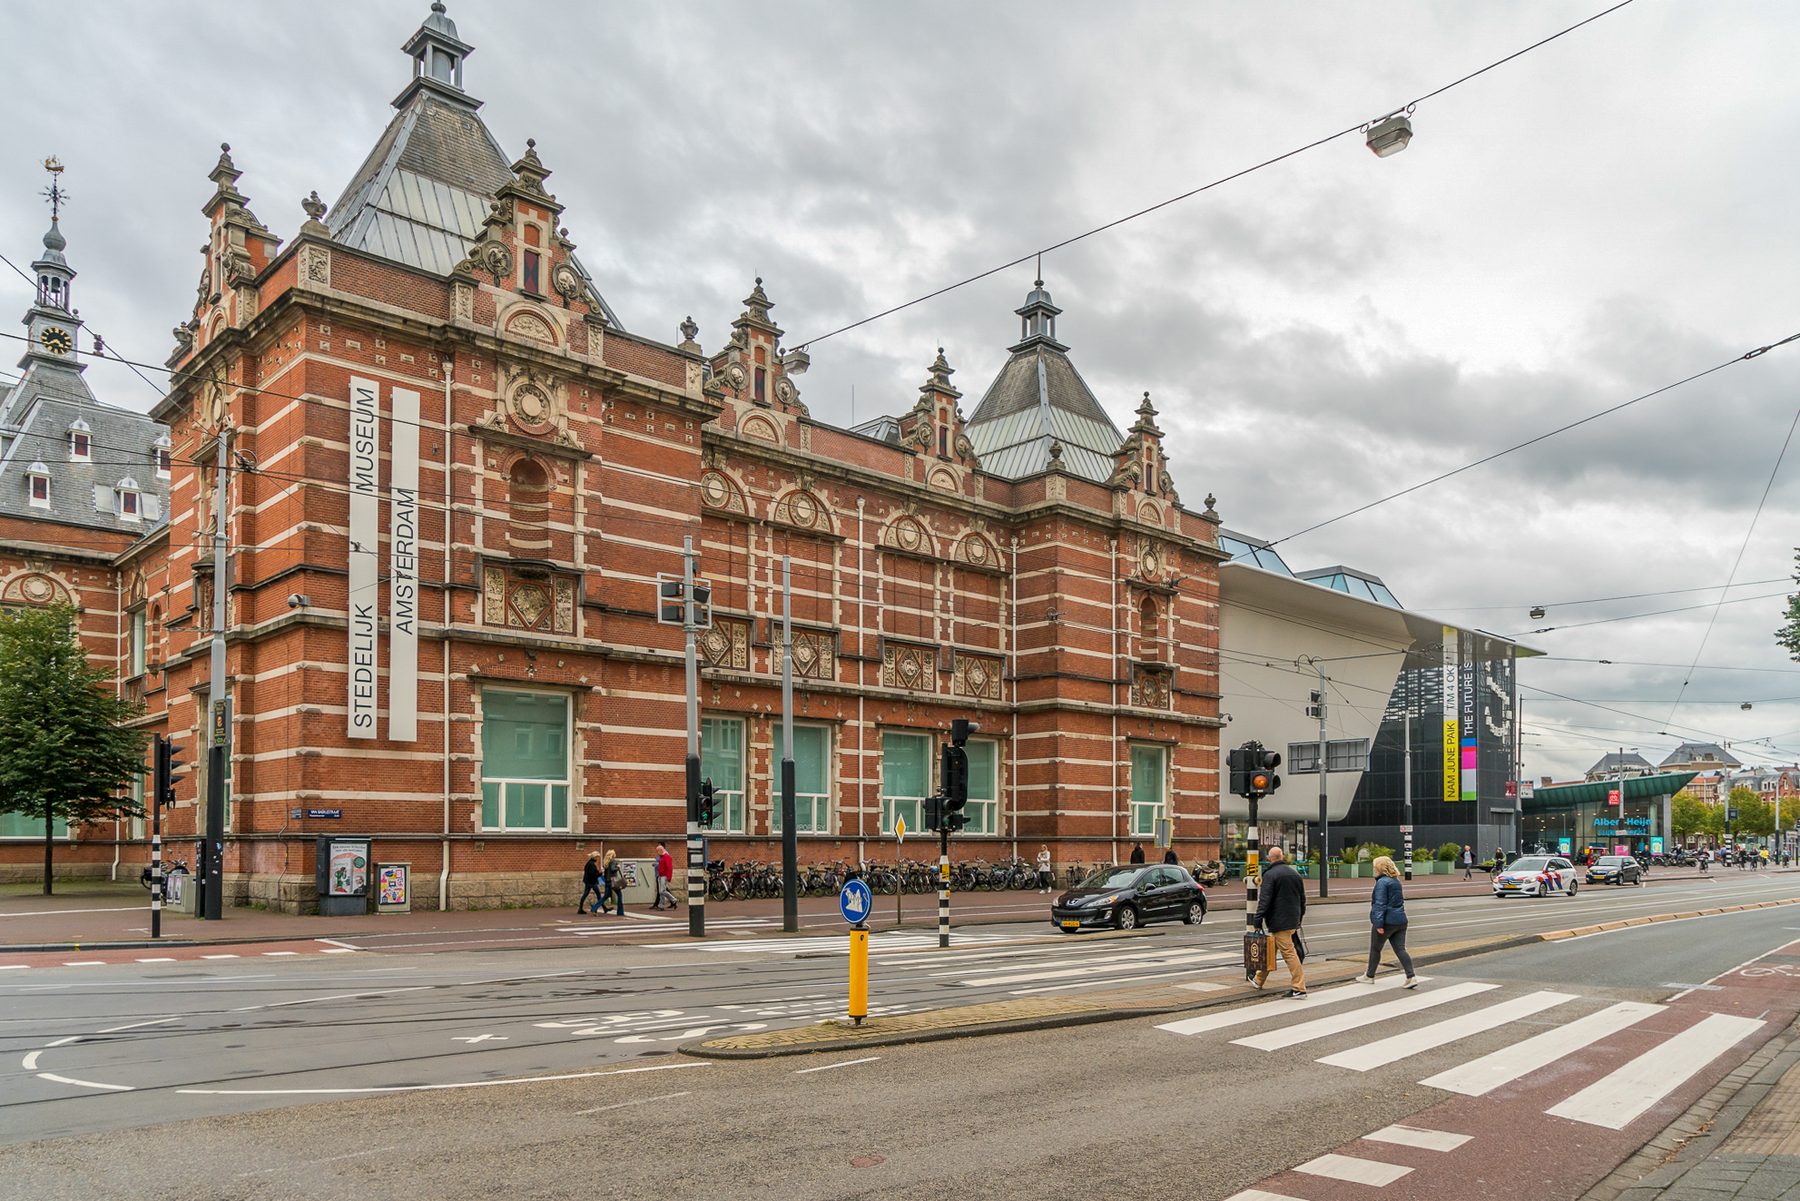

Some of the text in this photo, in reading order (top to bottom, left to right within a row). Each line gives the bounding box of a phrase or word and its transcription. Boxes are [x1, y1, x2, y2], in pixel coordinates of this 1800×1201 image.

[354, 387, 374, 728] STEDELIJK MUSEUM
[395, 488, 414, 635] AMSTERDAM
[1464, 661, 1474, 736] THE FUTURE IS
[1447, 722, 1455, 745] PAIK
[1447, 747, 1455, 773] JUNE
[1447, 775, 1455, 798] NAM
[1594, 817, 1653, 827] Alber Heijn
[532, 1009, 767, 1043] BUS
